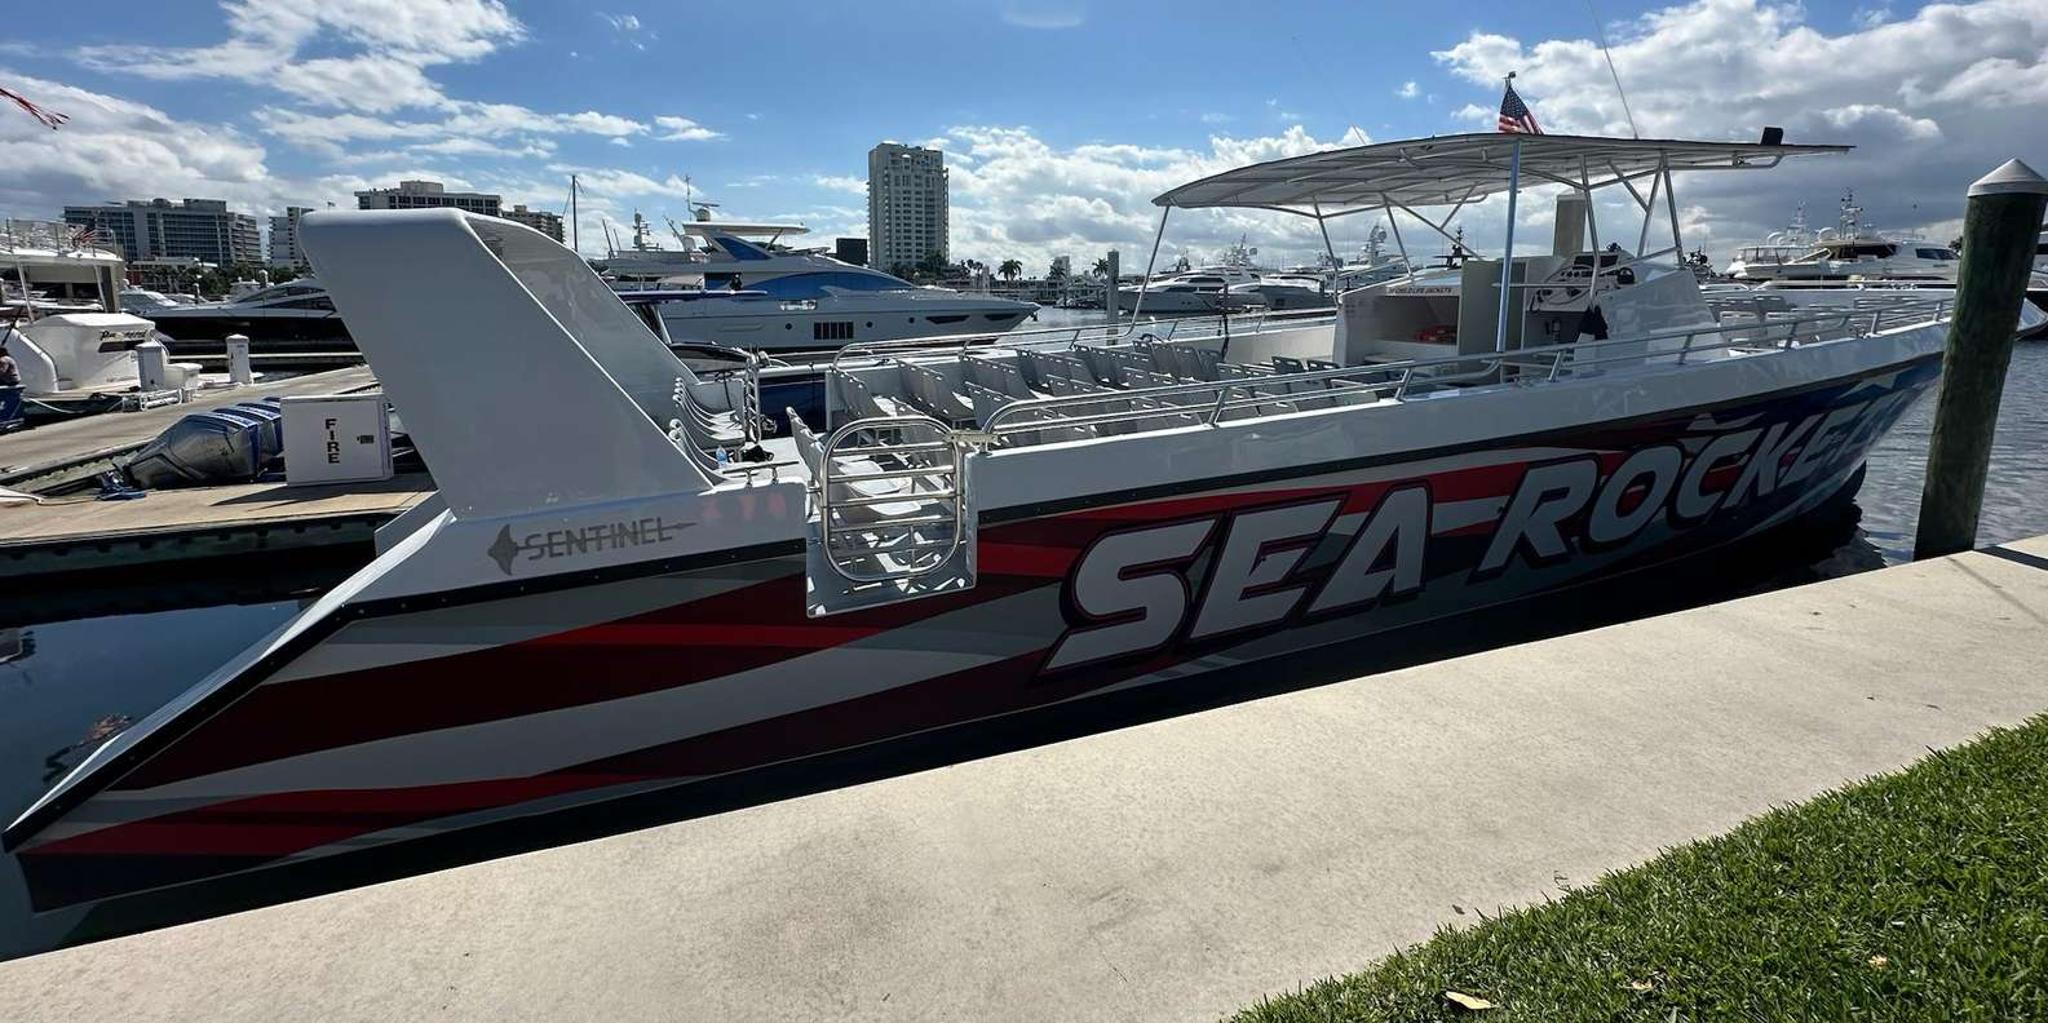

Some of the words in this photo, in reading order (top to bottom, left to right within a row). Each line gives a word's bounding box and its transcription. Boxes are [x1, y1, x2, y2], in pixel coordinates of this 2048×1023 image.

[325, 418, 340, 464] FIRE
[524, 516, 673, 561] SENTINEL
[1042, 483, 1430, 672] SEA
